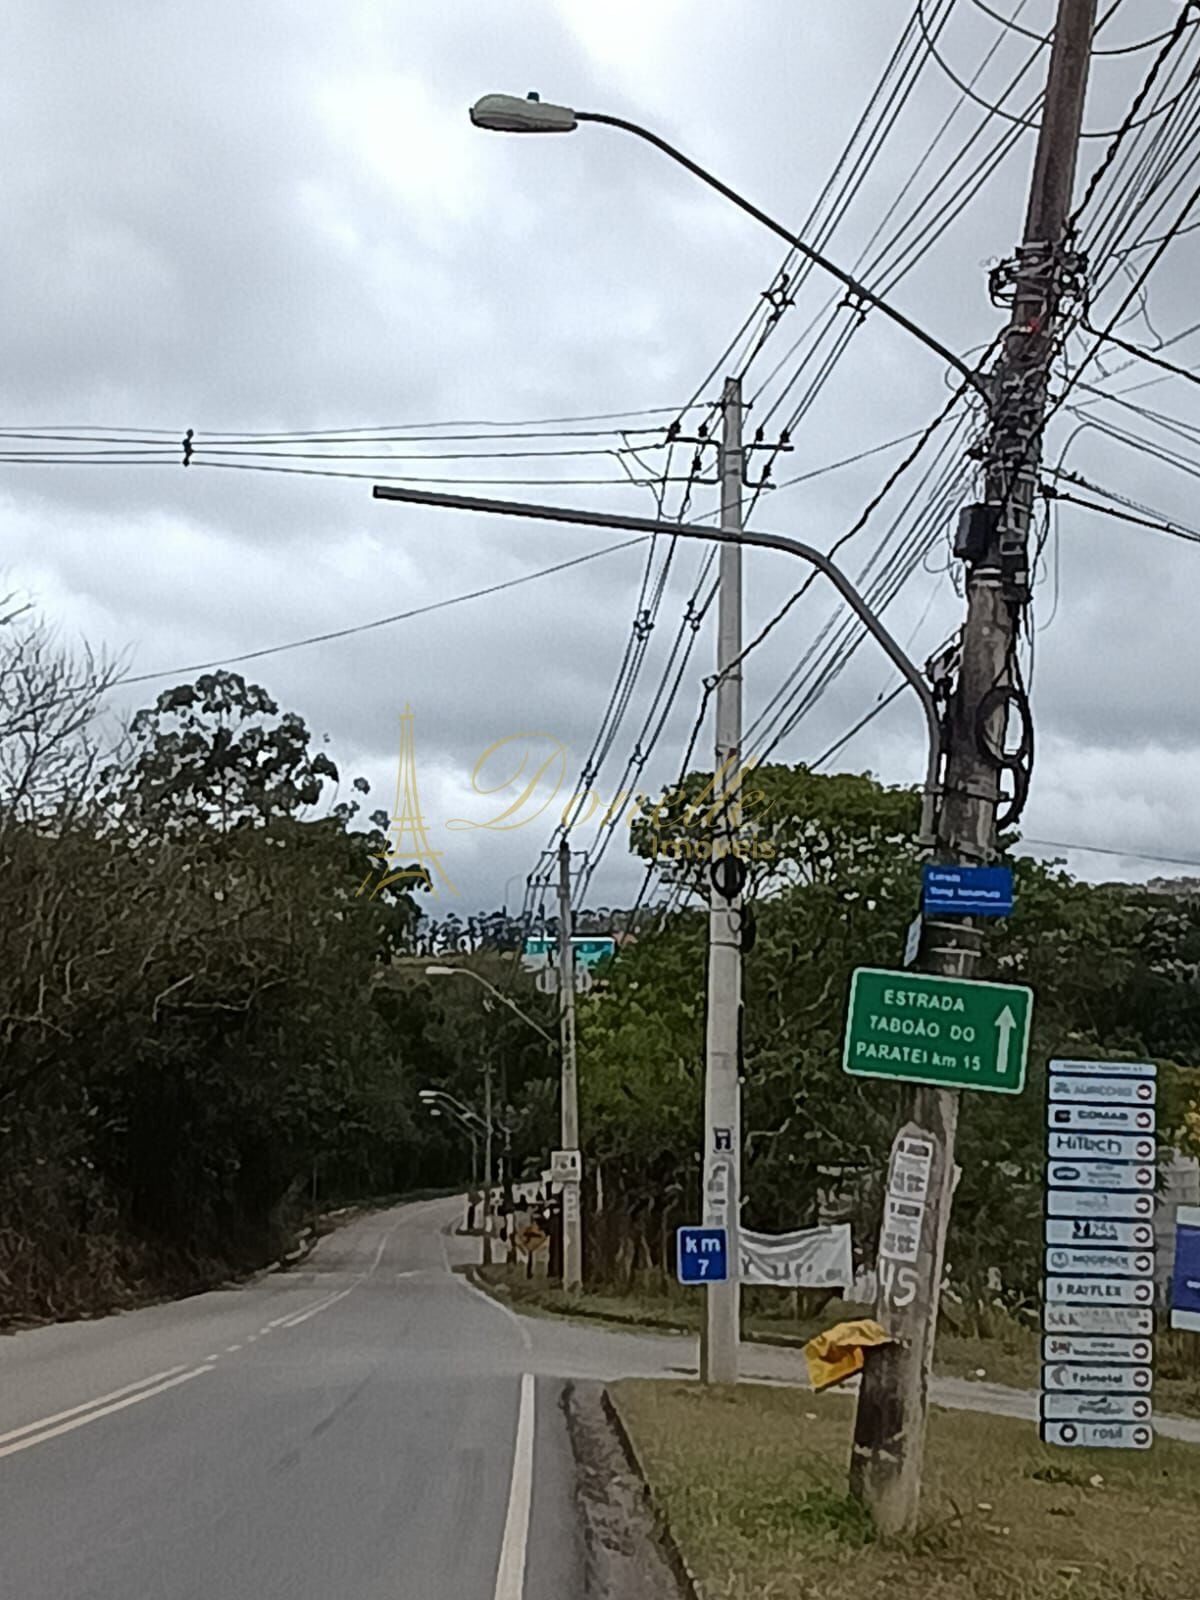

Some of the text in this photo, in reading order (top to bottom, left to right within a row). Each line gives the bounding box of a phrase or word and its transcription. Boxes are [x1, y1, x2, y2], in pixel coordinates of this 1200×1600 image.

[883, 989, 966, 1012] ESTRADA
[869, 1014, 976, 1043] TABOÃO DO
[856, 1041, 981, 1071] PARATEI km 15
[685, 1236, 721, 1253] km
[697, 1259, 710, 1276] 7
